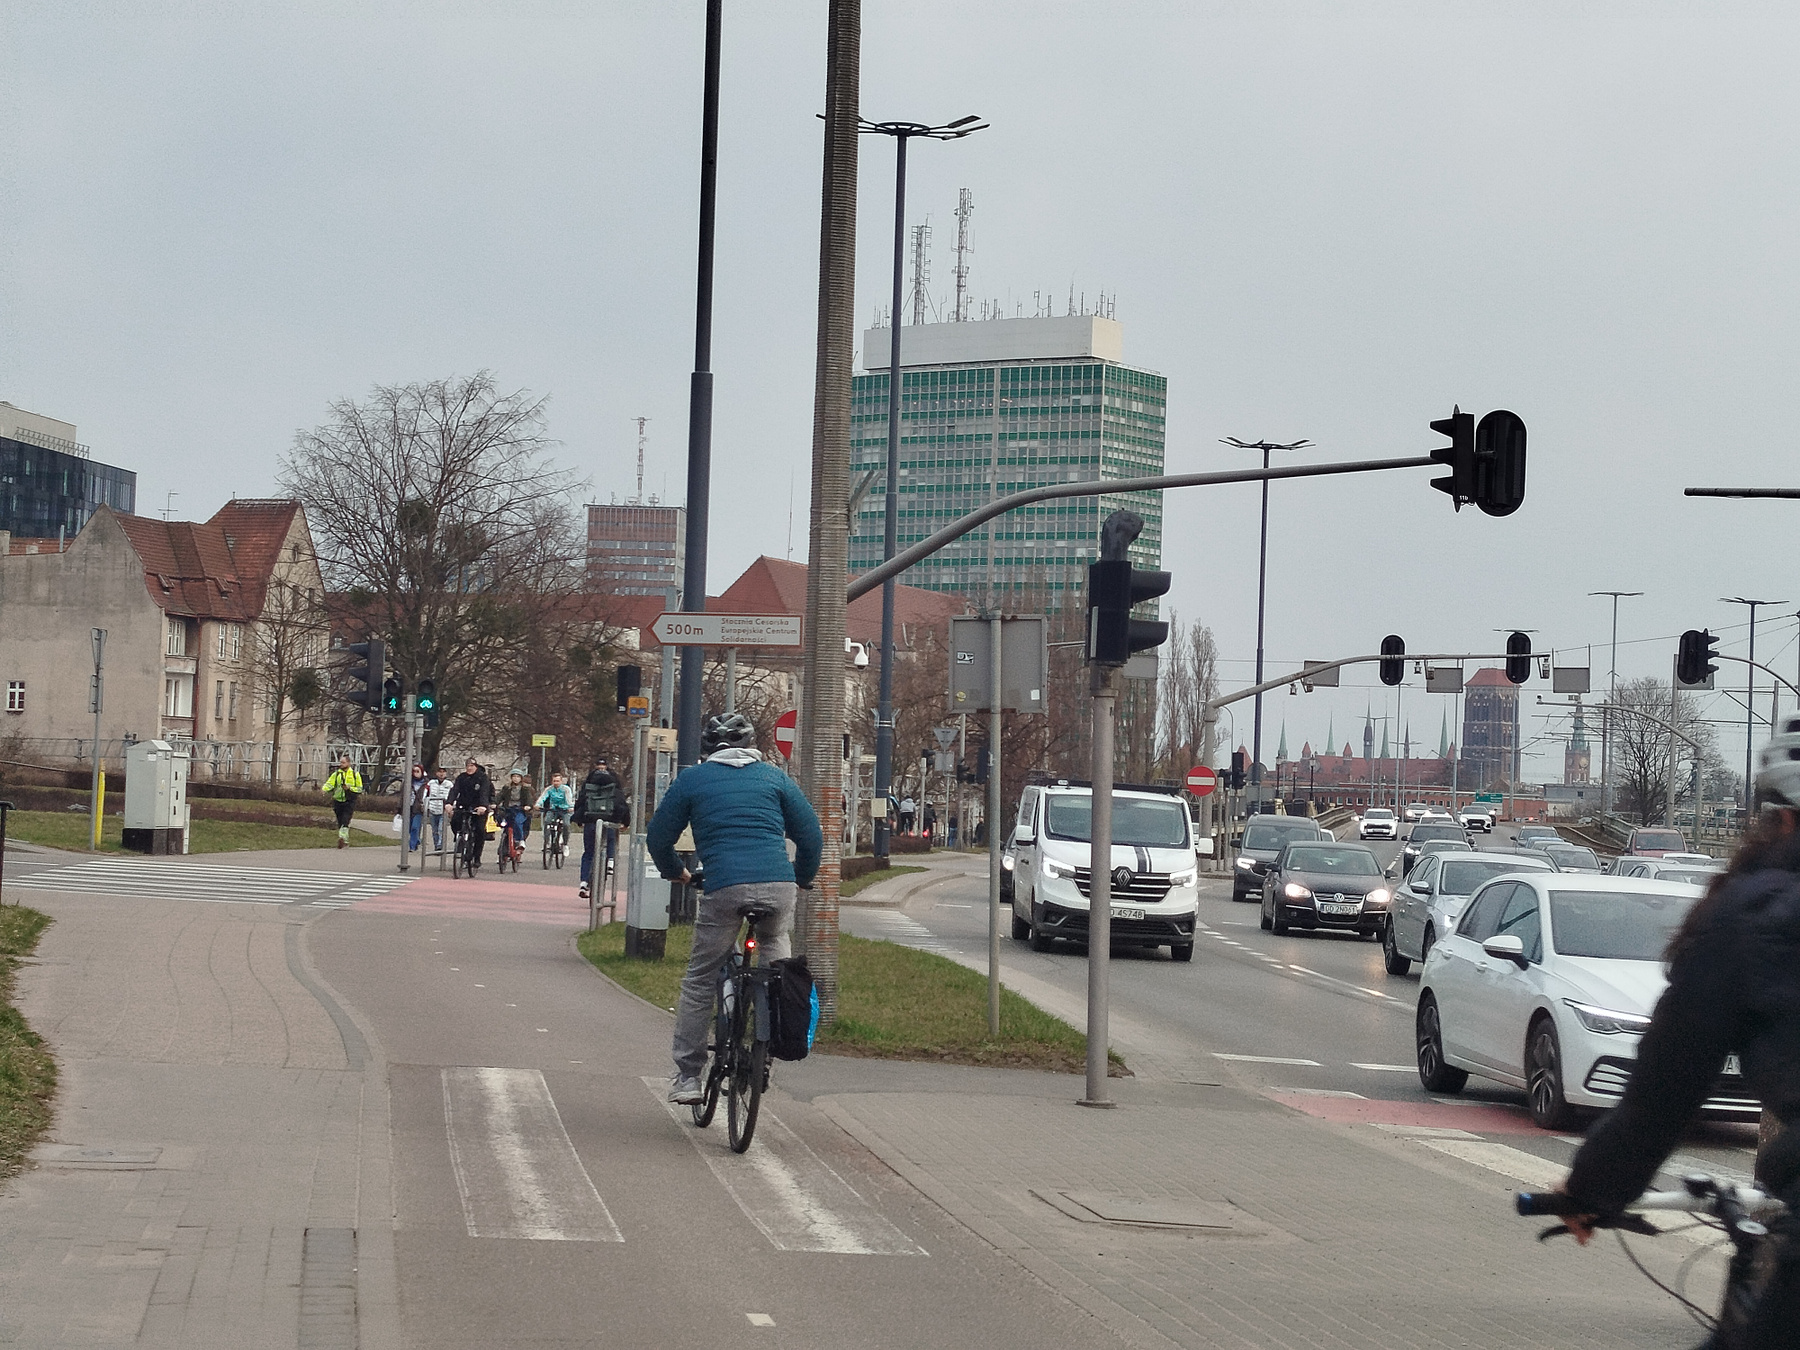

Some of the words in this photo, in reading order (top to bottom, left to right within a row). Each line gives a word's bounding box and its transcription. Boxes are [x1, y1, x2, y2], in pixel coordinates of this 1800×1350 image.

[666, 623, 704, 635] 500m
[721, 627, 764, 635] Europejskie
[765, 627, 798, 635] Centrum
